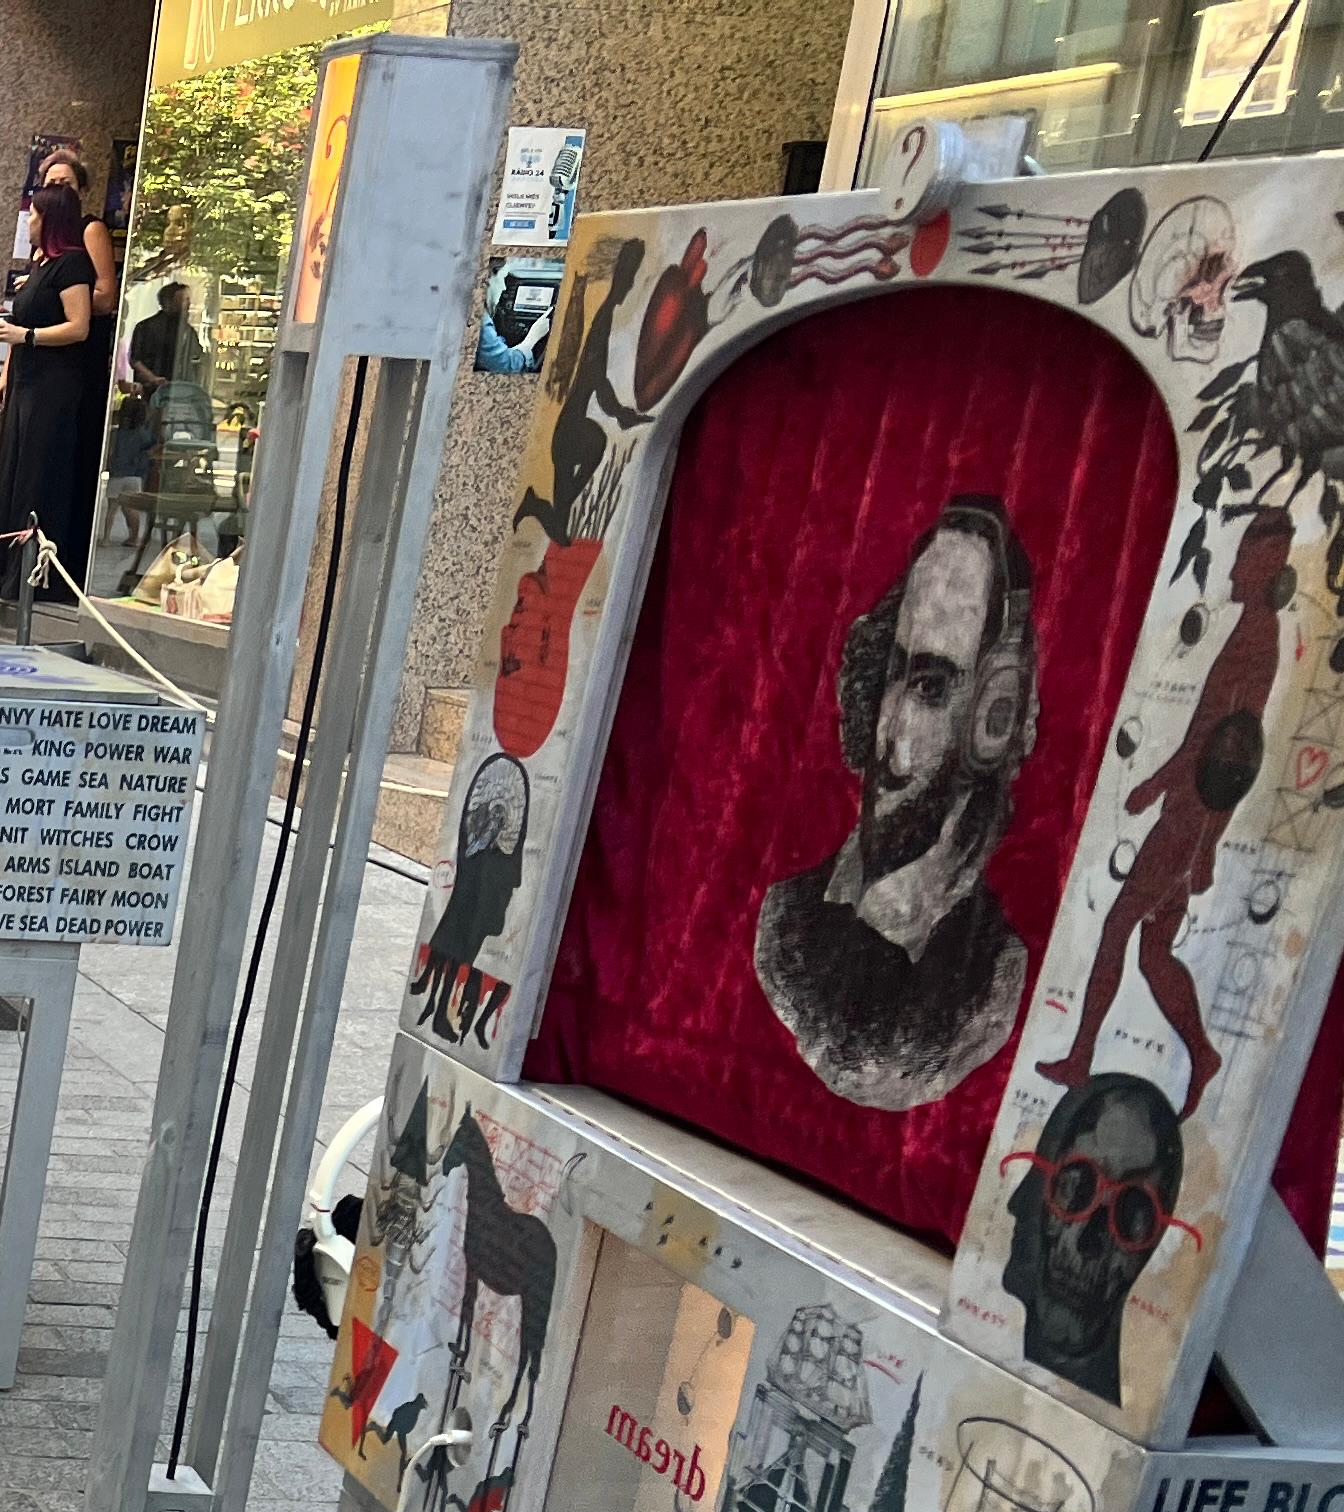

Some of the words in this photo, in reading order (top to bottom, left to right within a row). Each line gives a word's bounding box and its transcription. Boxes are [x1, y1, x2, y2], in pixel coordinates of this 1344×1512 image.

[39, 708, 84, 729] HATE
[87, 711, 133, 731] LOVE
[136, 714, 197, 735] DREAM
[31, 739, 77, 758] KING
[84, 742, 145, 762] POWER
[153, 745, 193, 765] WAR
[20, 768, 72, 788] GAME
[78, 771, 110, 790] SEA
[118, 773, 189, 793] NATURE
[4, 798, 56, 817] MORT
[62, 800, 127, 821] FAMILY
[132, 804, 186, 824] FIGHT
[39, 827, 115, 849] WITCHES
[124, 832, 180, 853] CROW
[3, 855, 52, 876] ARMS
[58, 858, 121, 879] ISLAND
[127, 862, 176, 882] BOAT
[59, 888, 109, 907] FAIRY
[110, 890, 170, 911] MOON
[18, 914, 50, 934] SEA
[55, 916, 103, 936] DEAD
[103, 919, 165, 939] POWER
